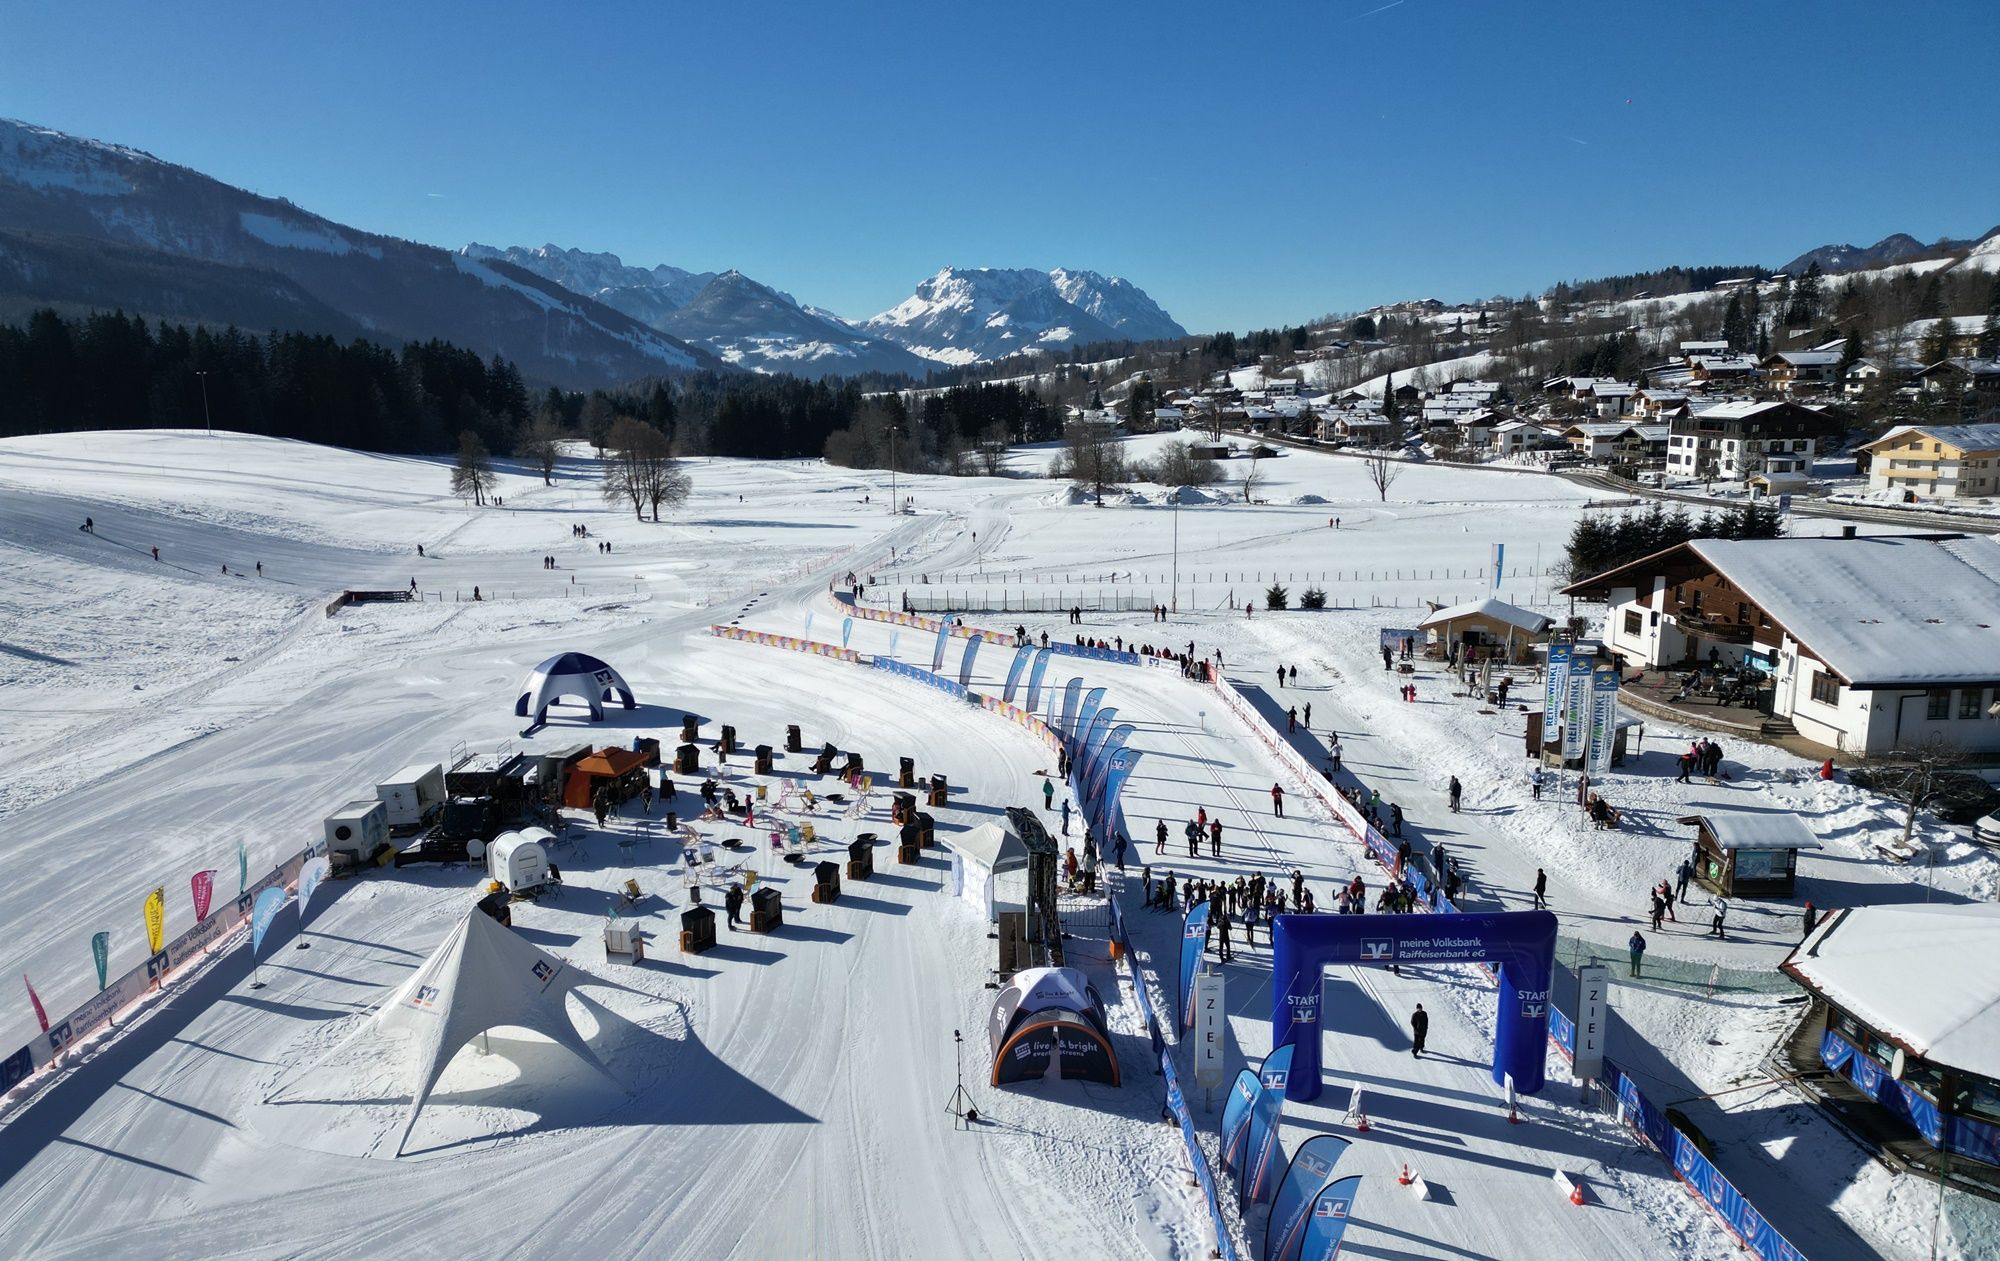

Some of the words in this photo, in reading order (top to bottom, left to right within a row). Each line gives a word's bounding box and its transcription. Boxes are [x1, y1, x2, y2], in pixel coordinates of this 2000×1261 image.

[188, 917, 216, 941] Volksbank
[1400, 938, 1430, 948] meine
[1432, 937, 1482, 947] Volksbank
[1400, 950, 1470, 959] Raiffeisenbank
[1472, 950, 1486, 958] eG
[1288, 994, 1320, 1005] START
[1518, 990, 1550, 1000] START
[1588, 990, 1598, 1050] ZIEL
[1207, 999, 1215, 1059] ZIEL
[1033, 1041, 1050, 1050] live
[1060, 1041, 1067, 1049] &
[1068, 1041, 1098, 1053] bright
